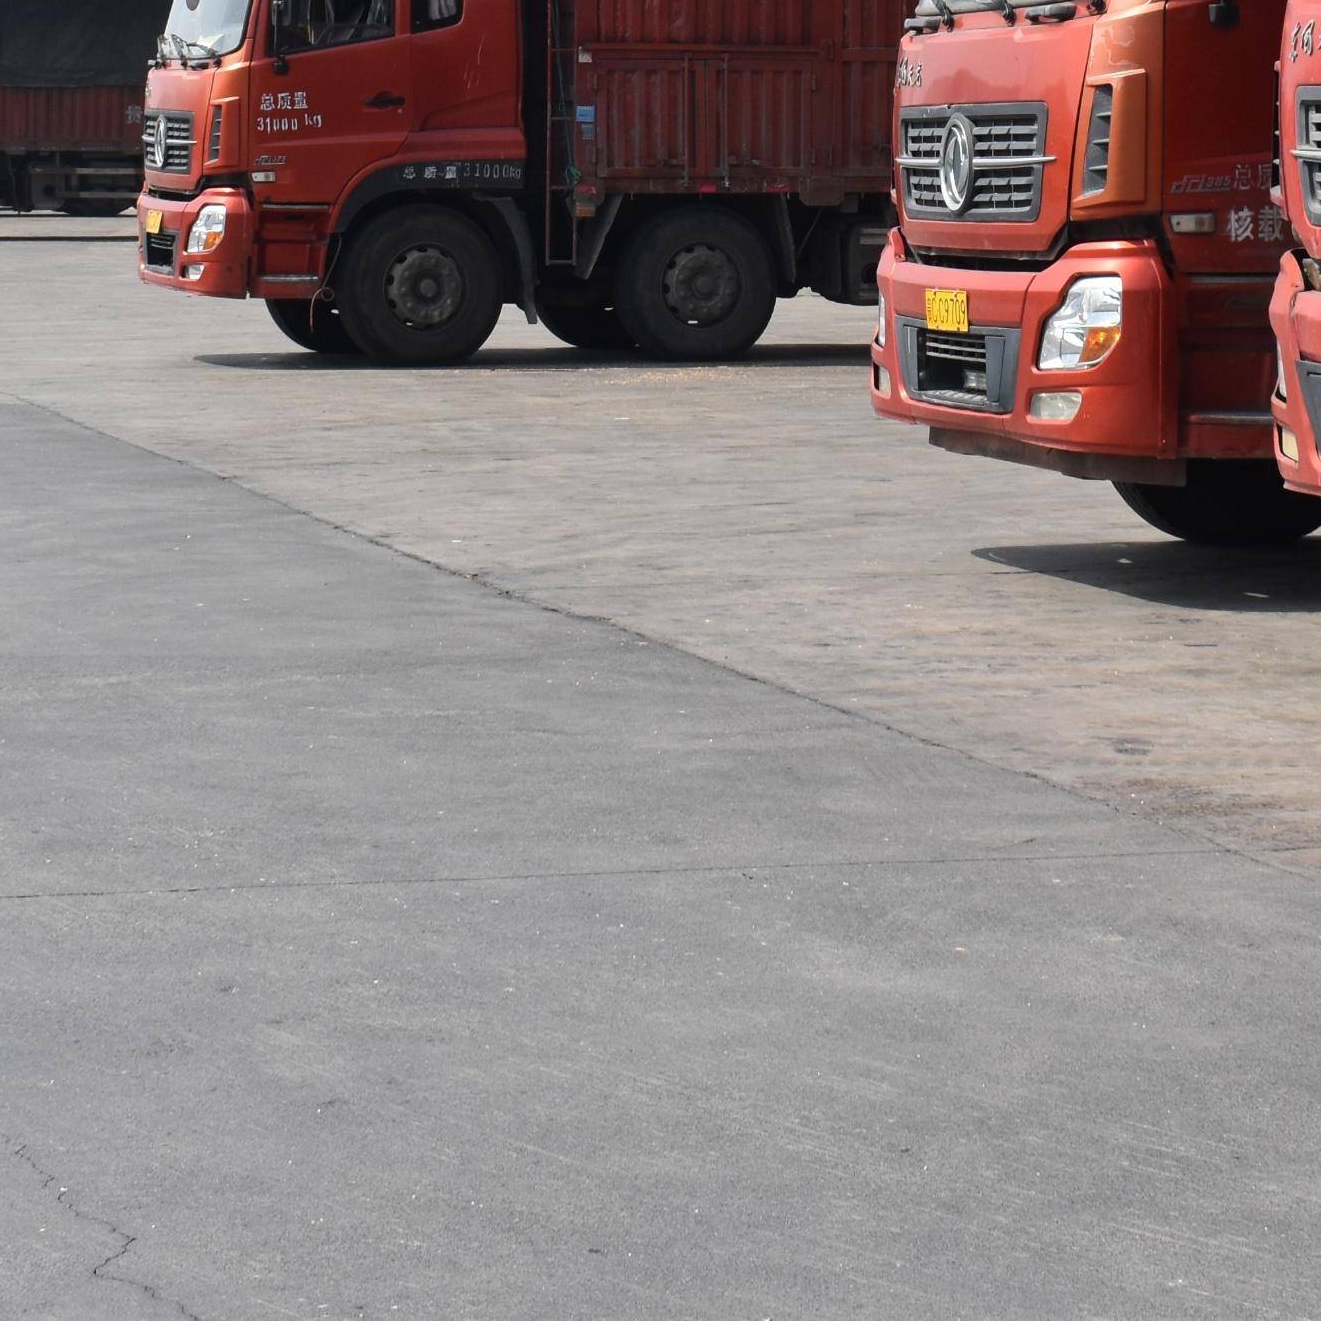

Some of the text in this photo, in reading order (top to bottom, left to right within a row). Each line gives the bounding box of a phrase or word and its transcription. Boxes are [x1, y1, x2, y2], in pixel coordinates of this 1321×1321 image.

[260, 91, 308, 111] 总质量
[1227, 205, 1285, 242] 核载
